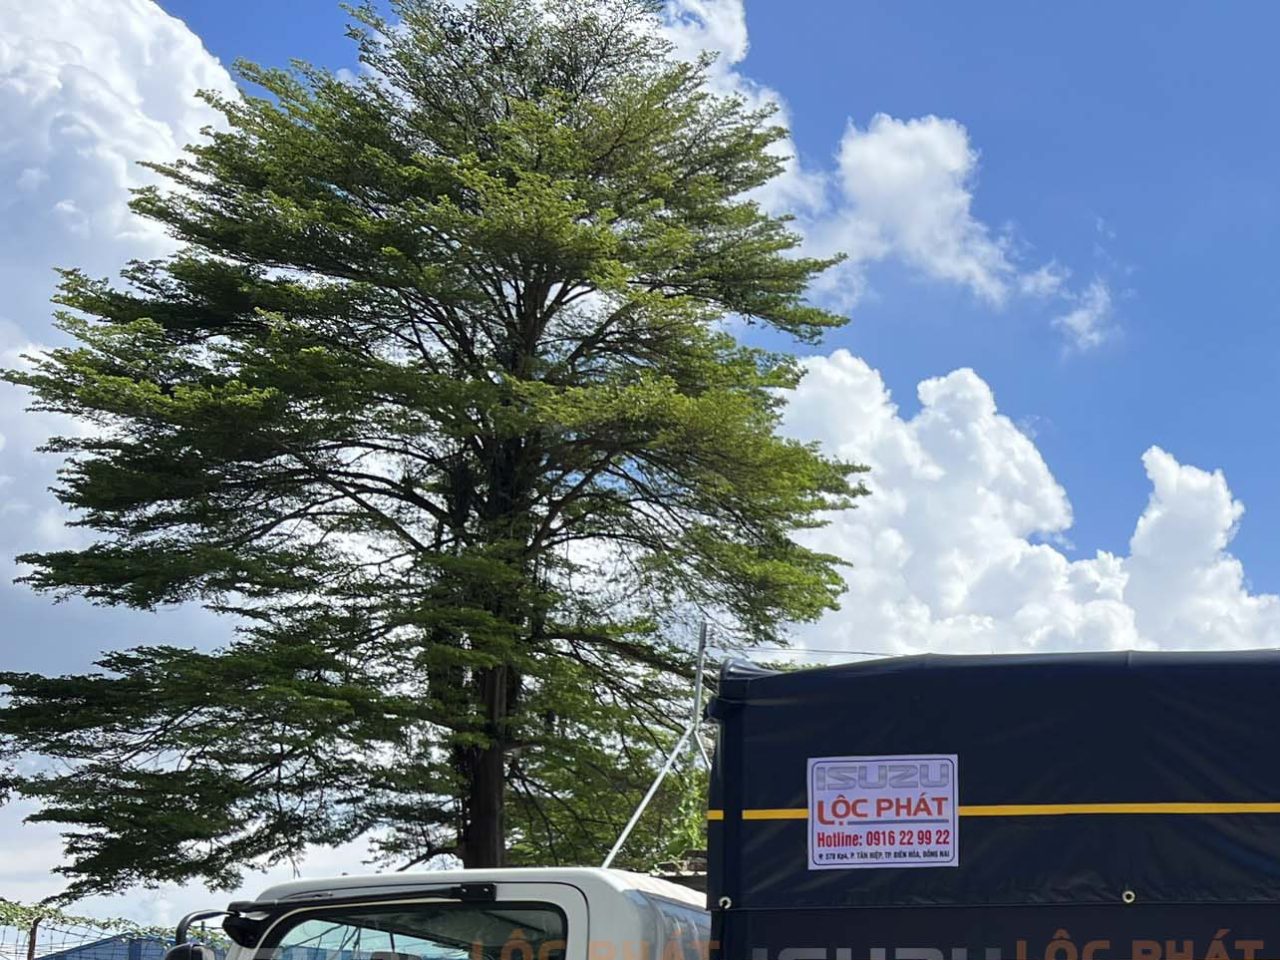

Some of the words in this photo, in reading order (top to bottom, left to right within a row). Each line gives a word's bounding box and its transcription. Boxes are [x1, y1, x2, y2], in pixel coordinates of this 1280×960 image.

[816, 764, 949, 791] ISUZU
[817, 794, 868, 826] LỘC
[876, 792, 948, 818] PHÁT
[817, 832, 863, 848] Hotline:
[866, 831, 895, 846] 0916
[899, 830, 914, 846] 22
[917, 830, 932, 845] 99
[935, 829, 950, 845] 22
